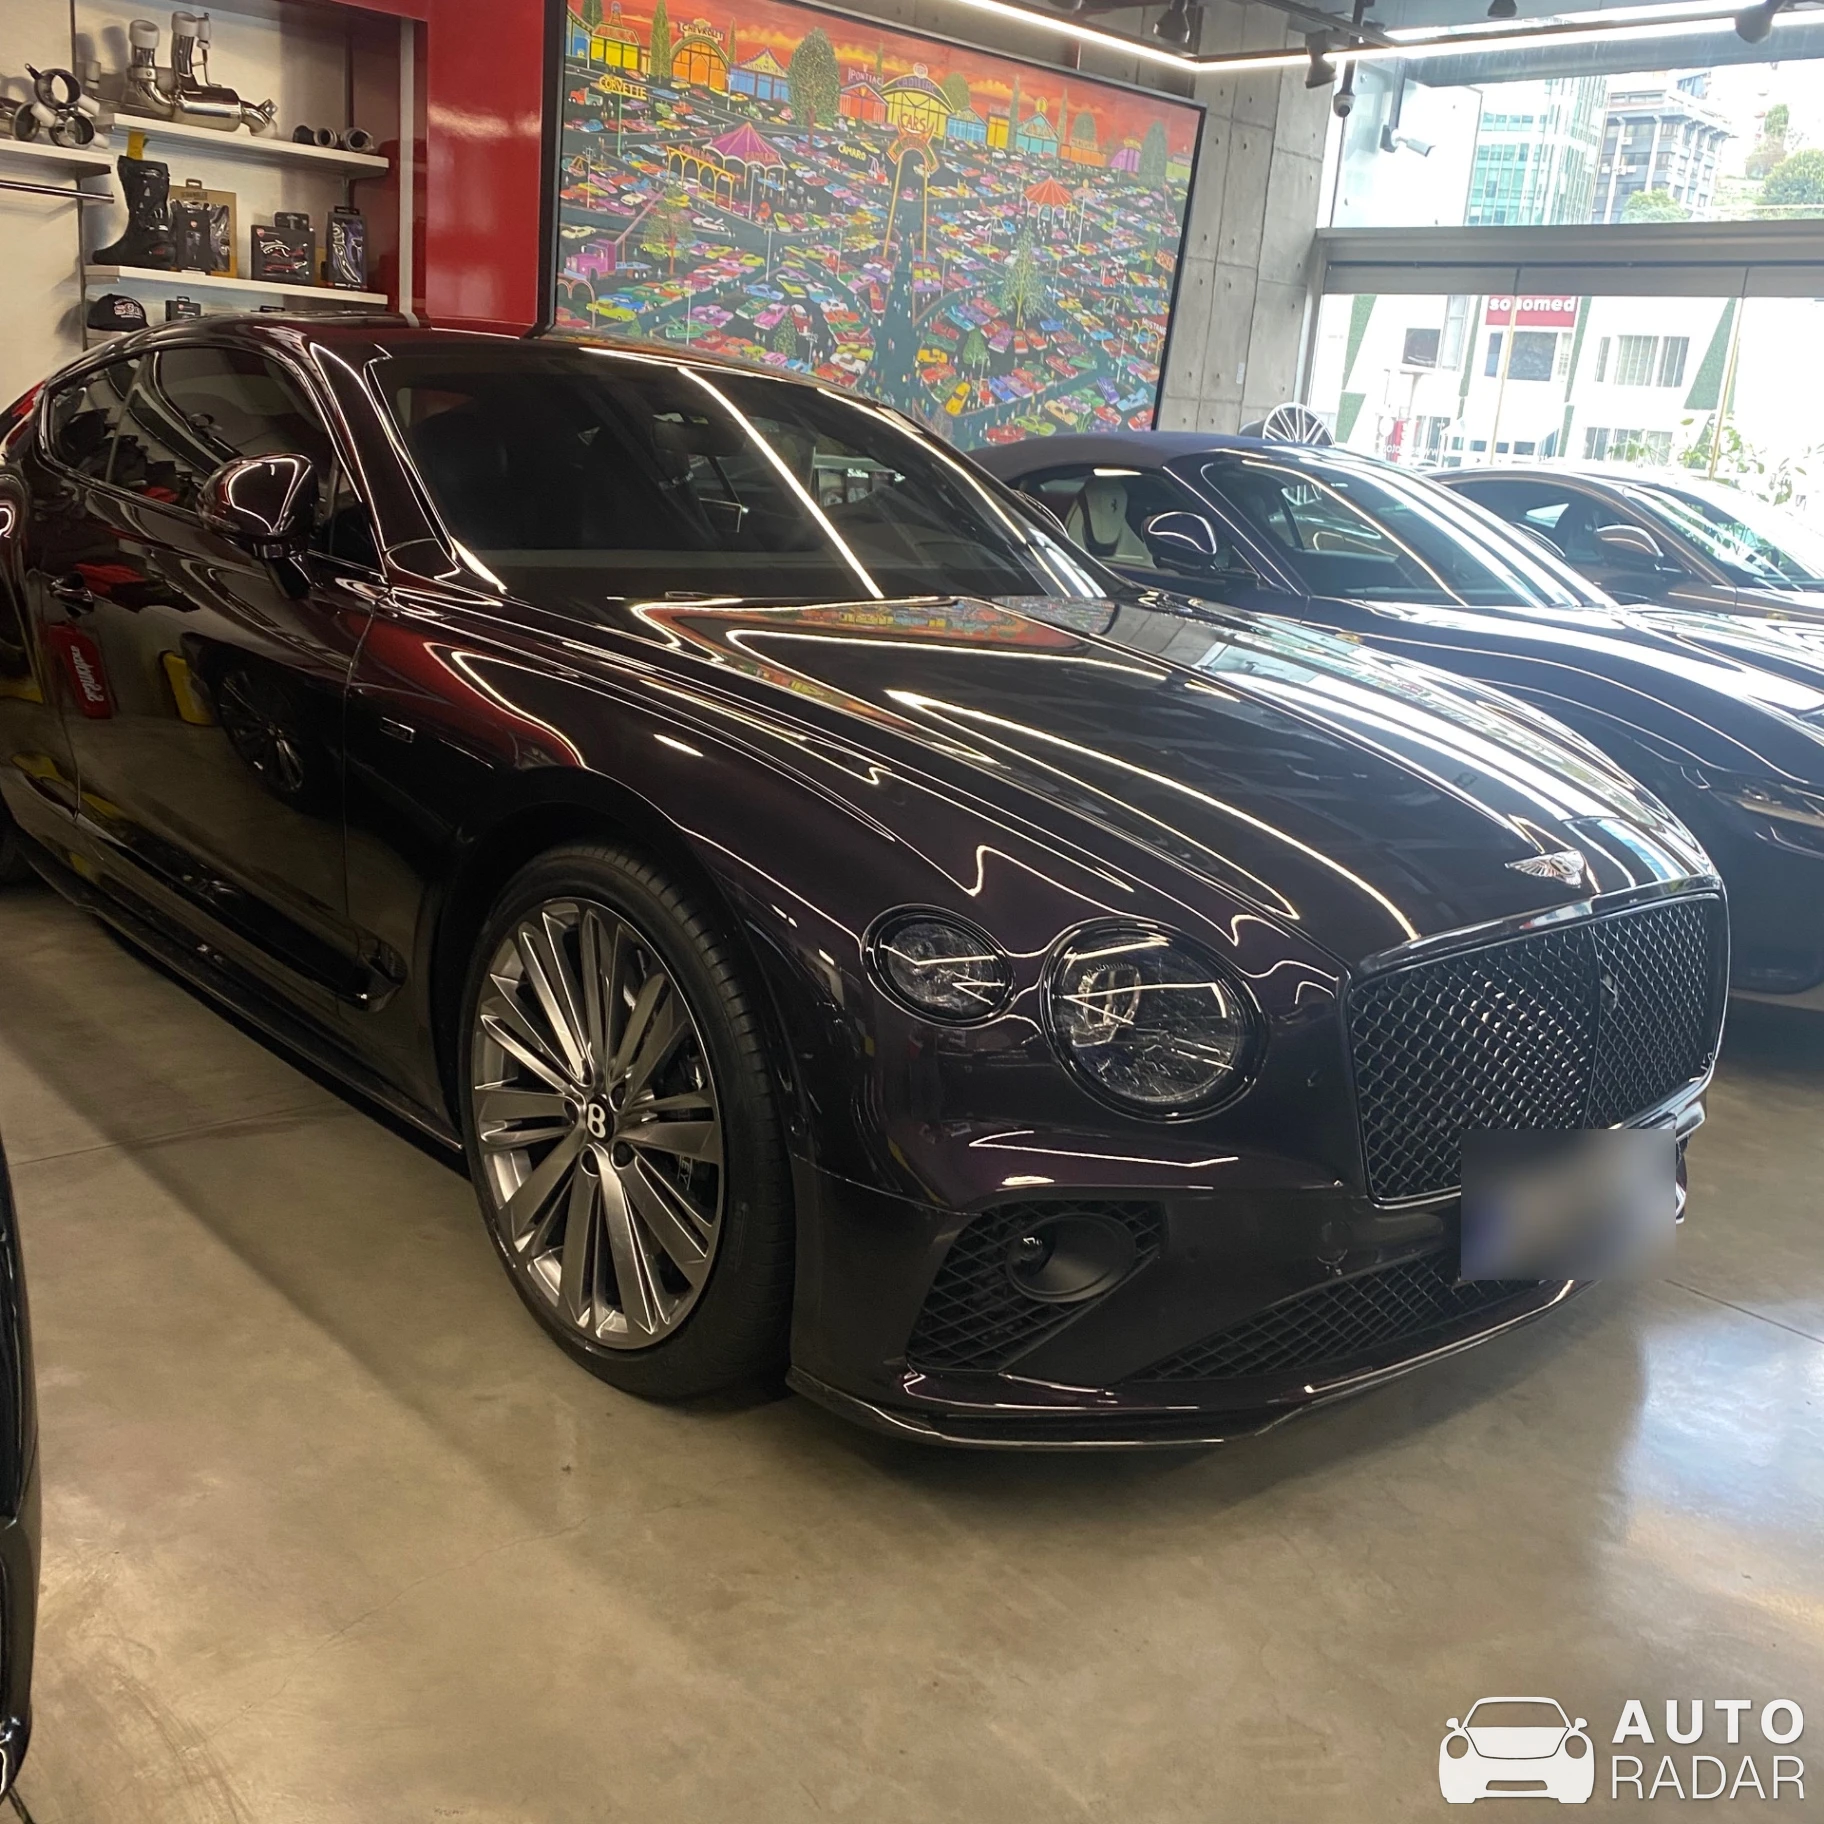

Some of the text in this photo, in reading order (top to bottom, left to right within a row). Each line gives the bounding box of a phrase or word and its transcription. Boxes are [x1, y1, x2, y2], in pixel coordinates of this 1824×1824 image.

[681, 22, 724, 41] CHEVROLET
[599, 73, 647, 99] CORVETTE
[850, 69, 884, 87] PONTIAC
[896, 77, 936, 94] CADILLAC
[900, 112, 926, 132] CARS
[837, 144, 867, 162] CAMARO
[586, 1103, 606, 1139] B
